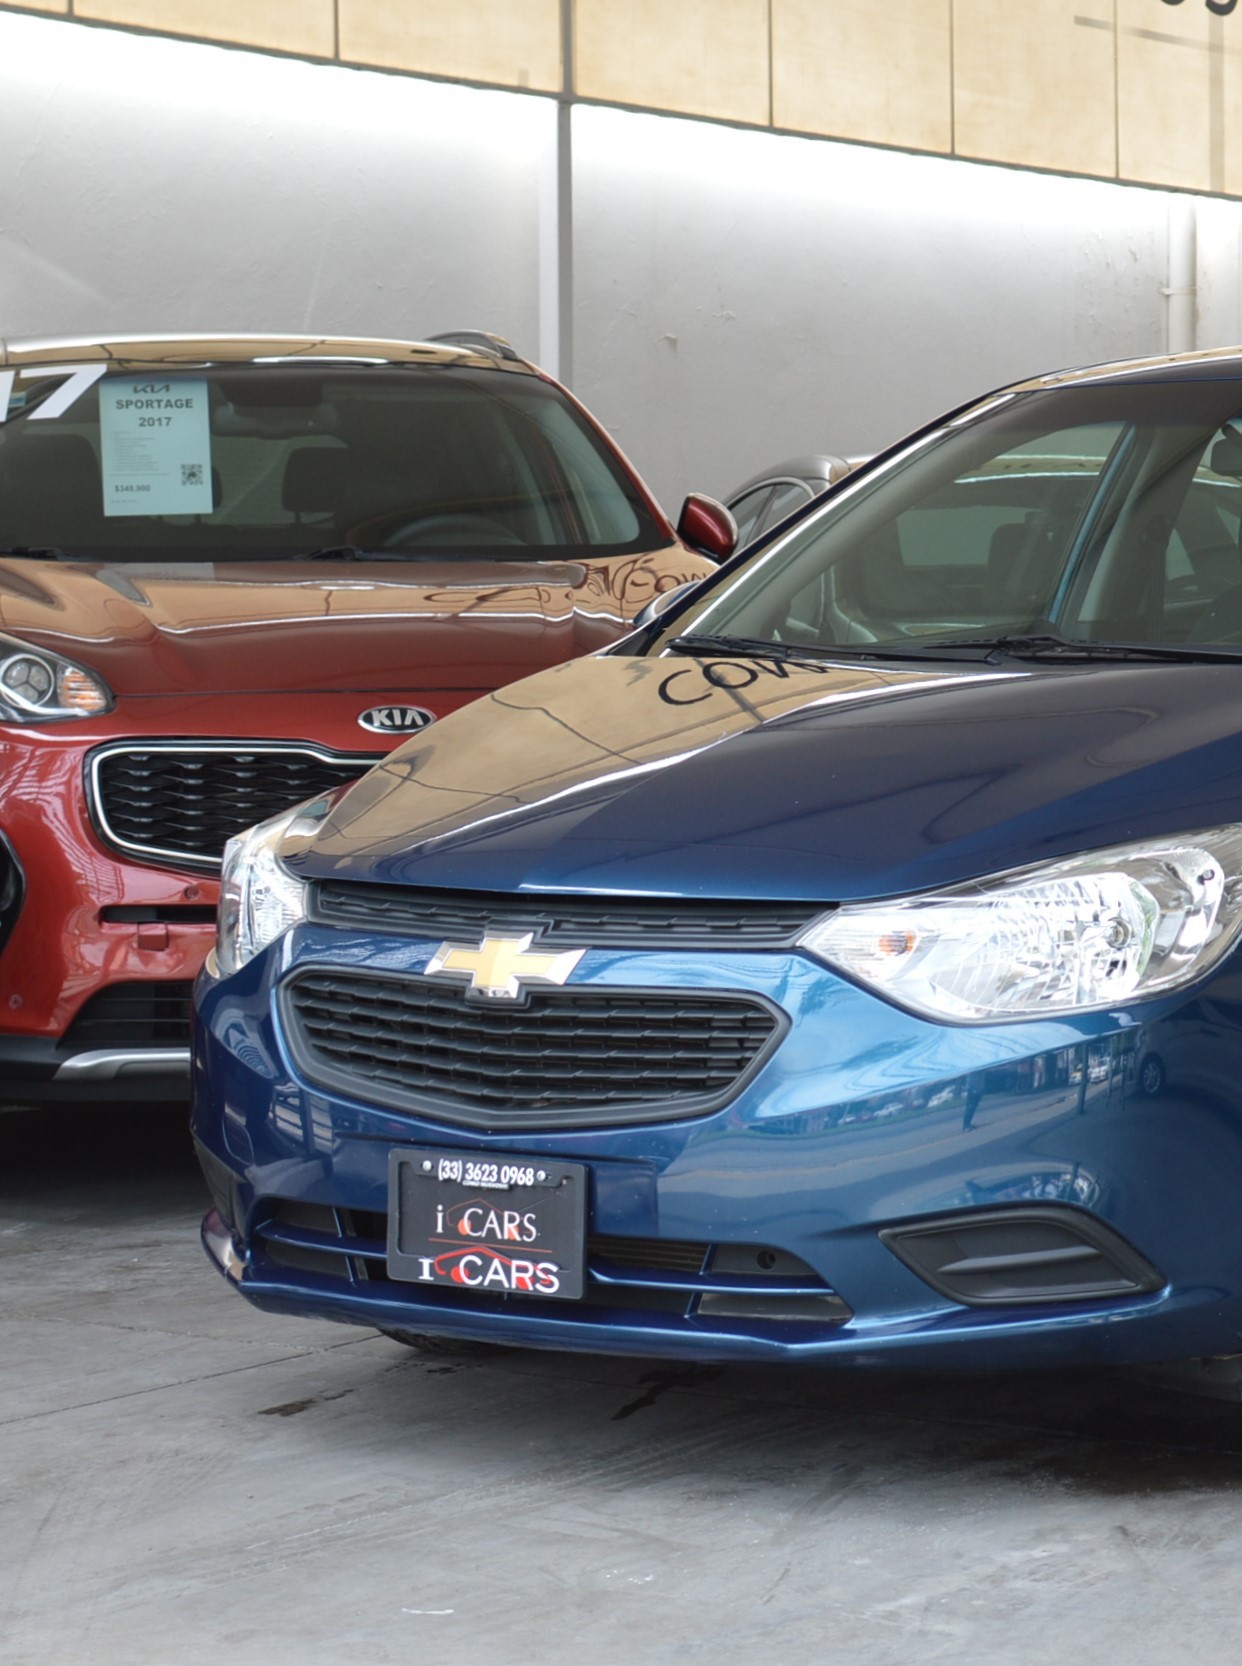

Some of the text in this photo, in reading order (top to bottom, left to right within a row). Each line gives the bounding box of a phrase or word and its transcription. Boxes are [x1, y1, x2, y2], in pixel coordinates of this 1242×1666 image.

[116, 398, 194, 410] SPORTAGE
[138, 416, 172, 427] 2017
[371, 709, 425, 726] KIA
[438, 1158, 463, 1182] (33)
[465, 1162, 498, 1182] 3623
[501, 1165, 534, 1186] 0968
[436, 1204, 538, 1242] i CARS
[459, 1255, 560, 1294] CARS
